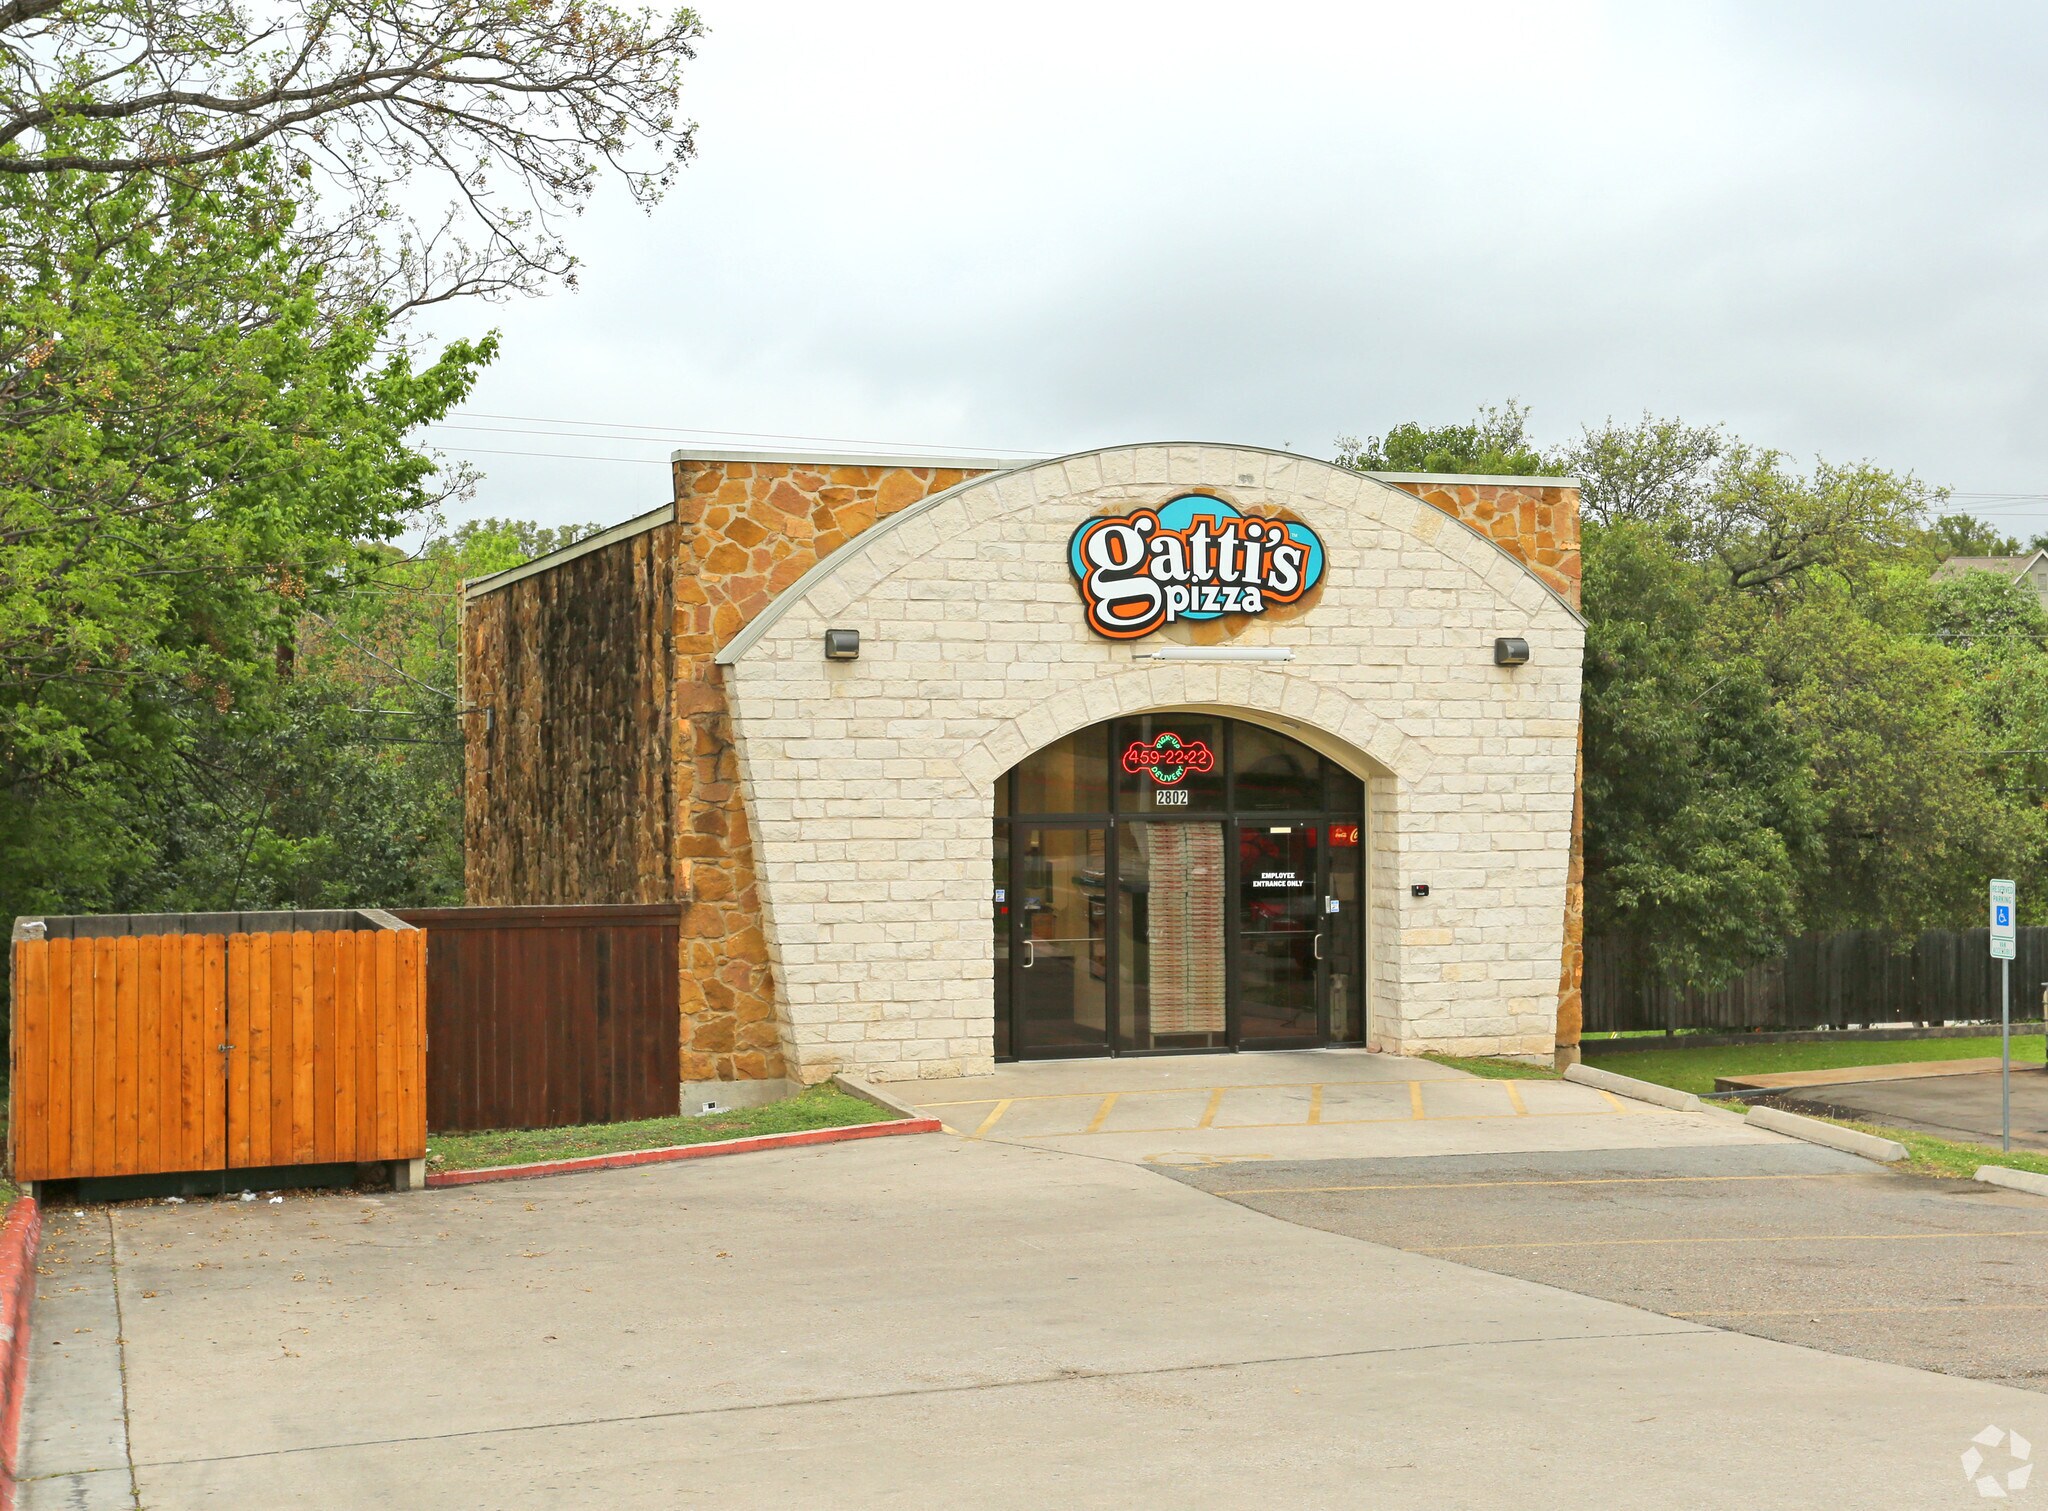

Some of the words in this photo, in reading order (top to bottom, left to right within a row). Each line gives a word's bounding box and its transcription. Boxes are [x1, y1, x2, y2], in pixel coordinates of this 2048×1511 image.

[1088, 517, 1301, 626] gatti's
[1164, 574, 1264, 622] pizza
[1156, 734, 1181, 749] PICK-UP
[1151, 765, 1184, 781] DELIVERY
[1157, 790, 1187, 804] 2802
[1992, 885, 2013, 895] RESERVED
[1993, 894, 2012, 904] PARKING
